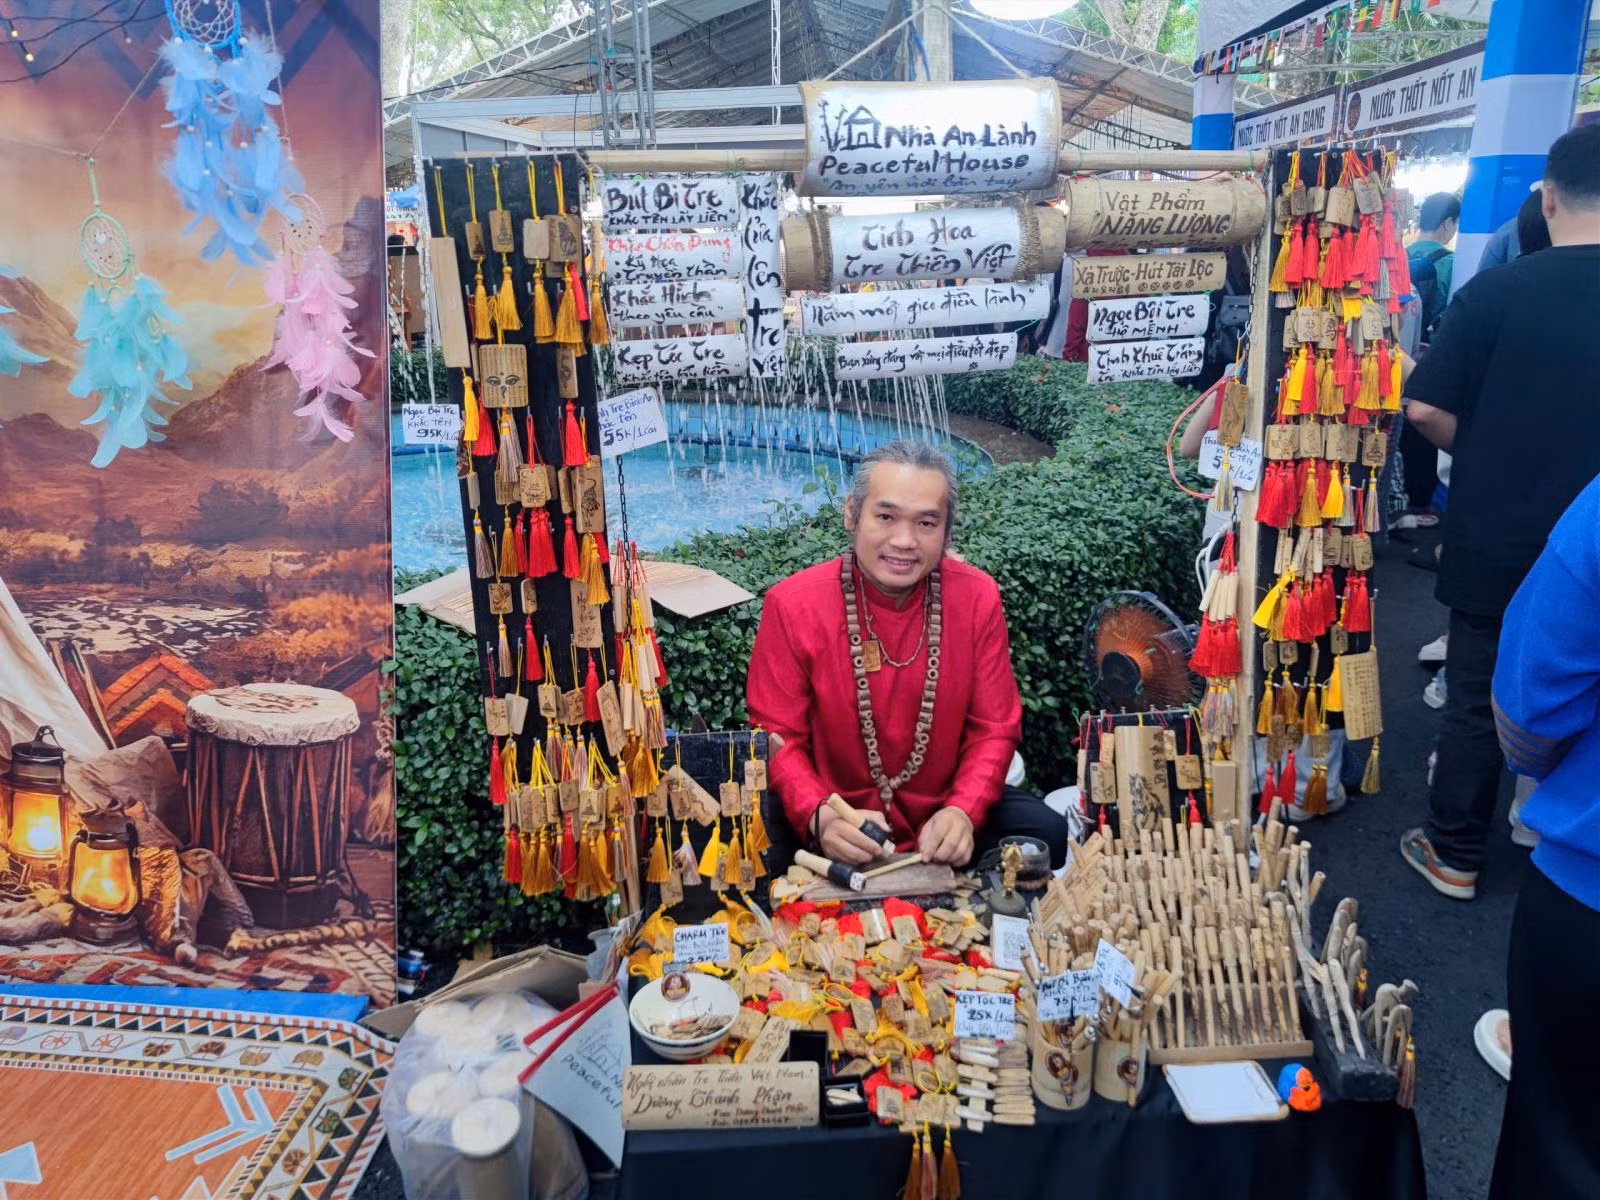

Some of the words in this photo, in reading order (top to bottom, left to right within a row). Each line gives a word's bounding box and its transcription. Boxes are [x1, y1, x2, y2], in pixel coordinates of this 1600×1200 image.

[1370, 88, 1395, 120] NƯỚC
[1400, 77, 1427, 114] THỐT
[1429, 69, 1454, 107] NỐT
[1457, 65, 1476, 100] AN
[885, 124, 936, 147] Nhà
[942, 124, 975, 147] An
[982, 122, 1037, 147] Lành
[1256, 117, 1271, 144] THỐT
[1273, 113, 1287, 139] NỐT
[1289, 113, 1300, 136] AN
[1302, 106, 1325, 133] GIANG
[820, 150, 938, 176] Peaceful
[947, 152, 1029, 173] House
[607, 182, 649, 213] Bút
[653, 183, 680, 212] Bi
[682, 181, 722, 209] Tre
[1105, 190, 1141, 214] Vật
[1149, 188, 1205, 211] Phẩm
[928, 216, 976, 245] Hoa
[1100, 212, 1164, 235] NĂNG
[1164, 213, 1230, 237] LƯỢNG
[844, 254, 884, 277] Tre
[964, 244, 1015, 273] Việt
[1075, 265, 1095, 285] Xả
[1167, 261, 1186, 279] Tài
[1188, 259, 1213, 280] Lộc
[1165, 300, 1195, 319] Tre
[689, 340, 725, 360] Tre
[752, 354, 785, 376] Việt
[837, 356, 860, 371] Bạn
